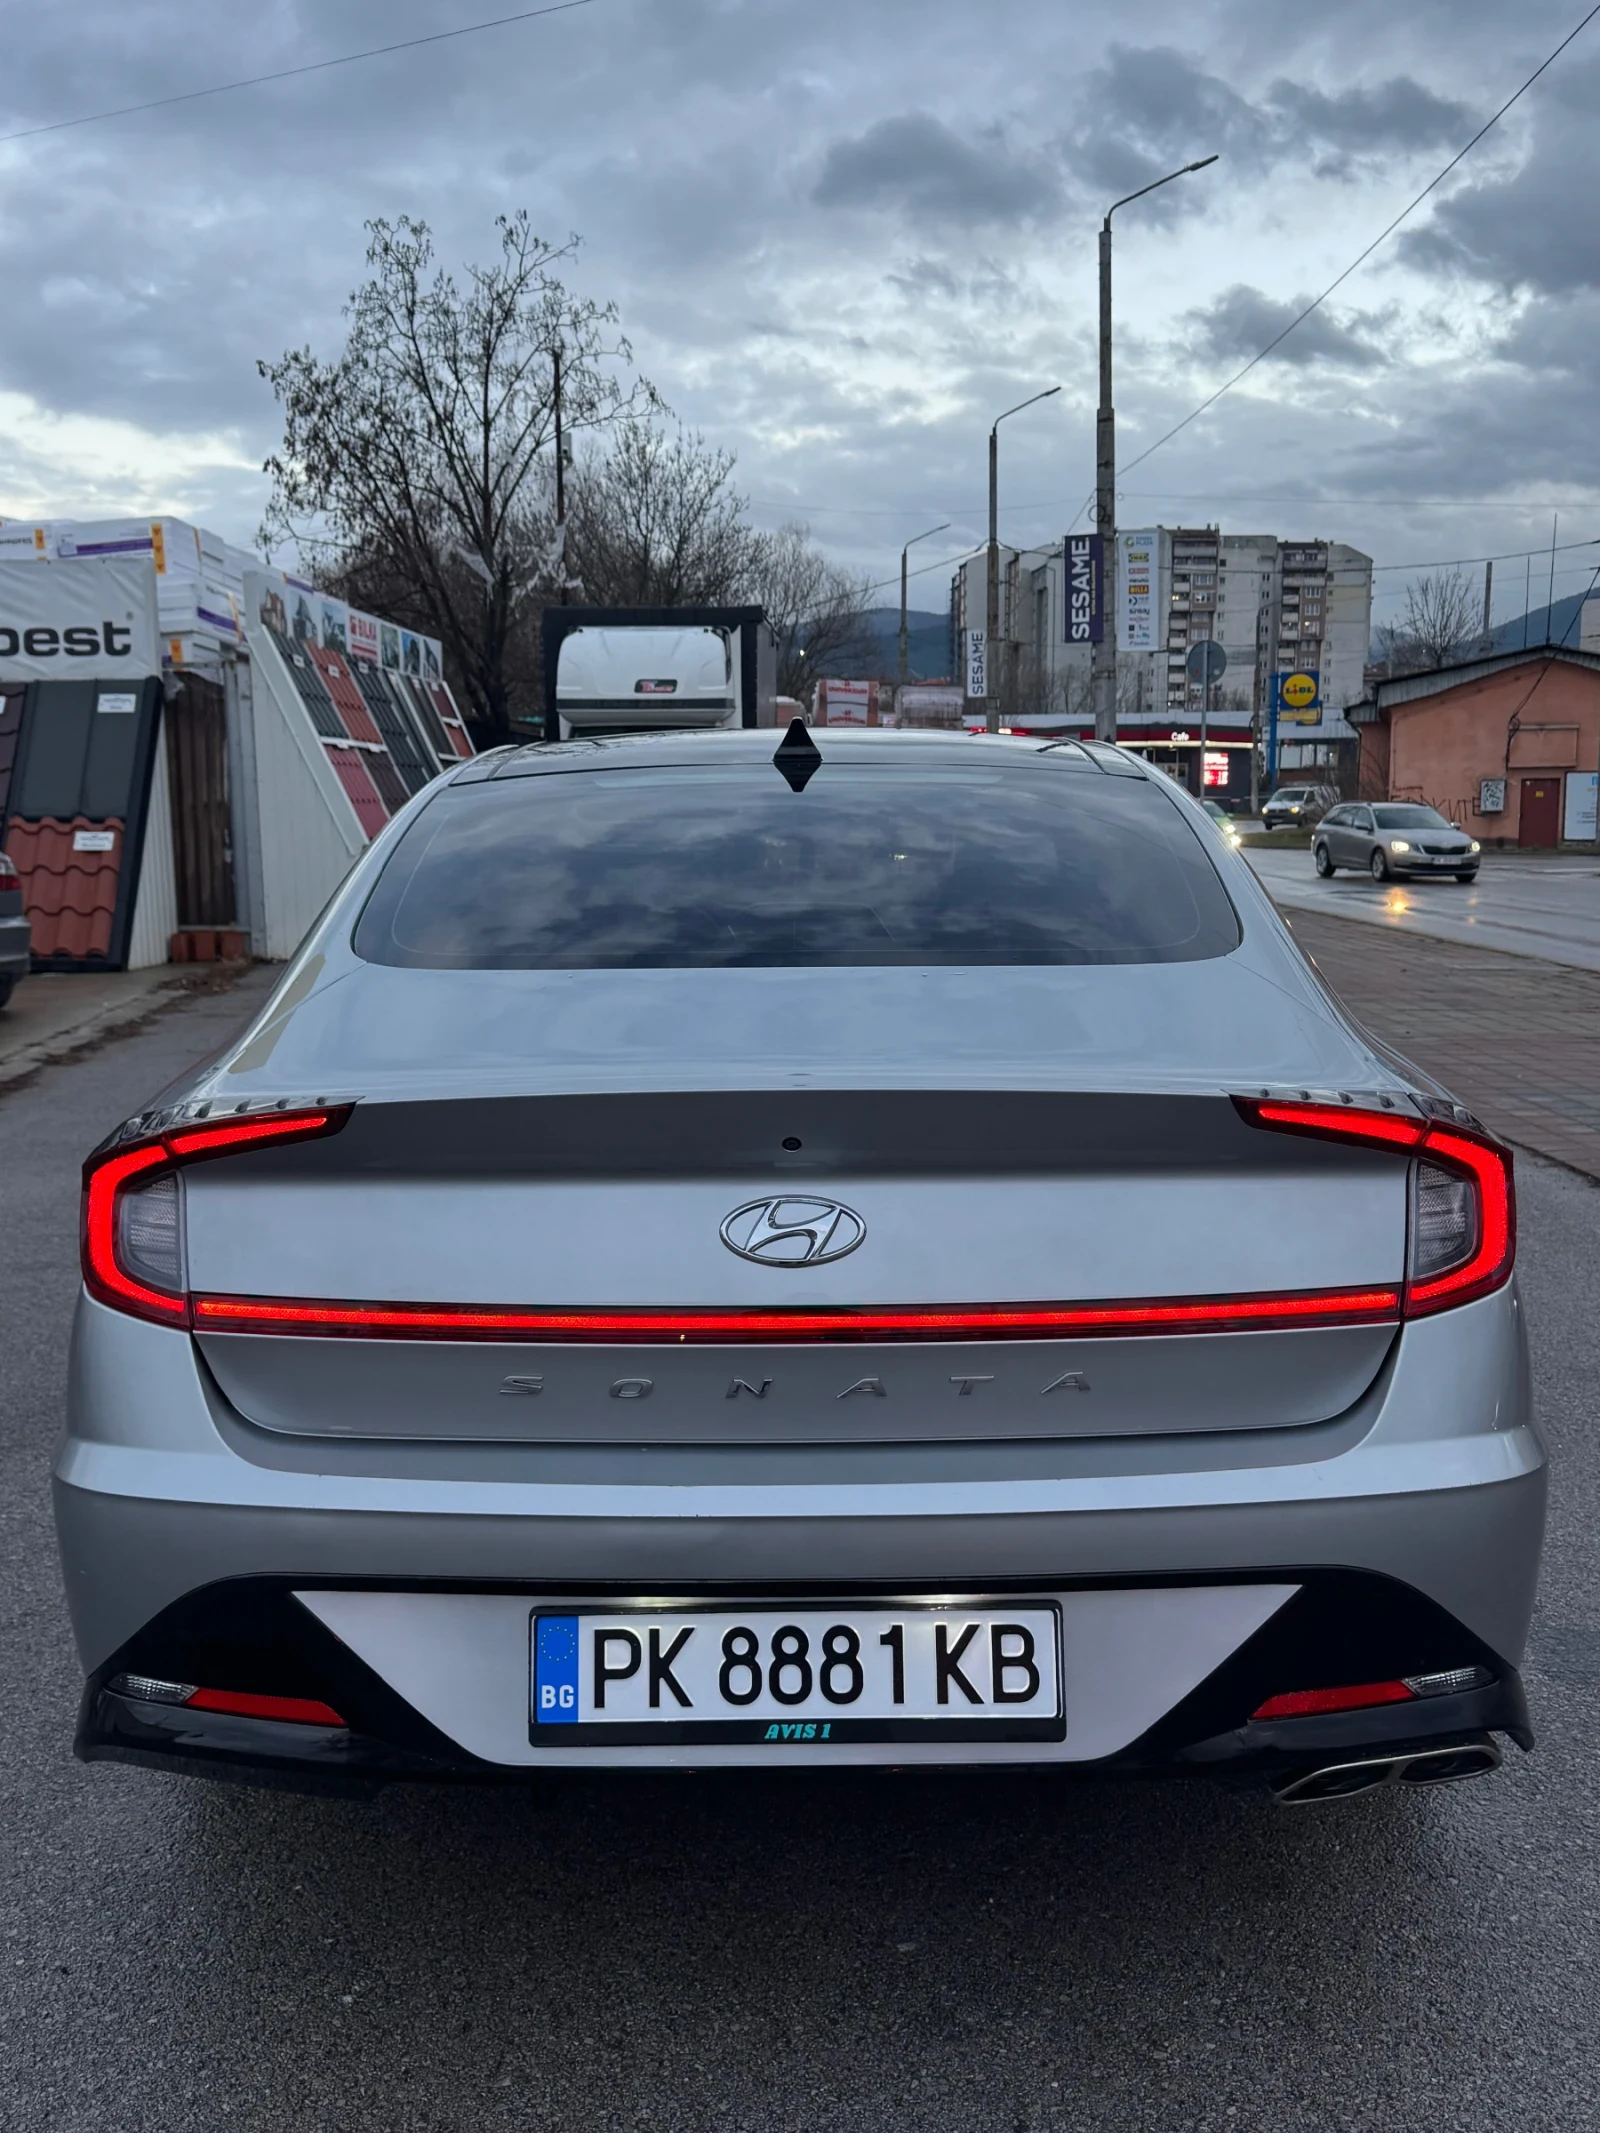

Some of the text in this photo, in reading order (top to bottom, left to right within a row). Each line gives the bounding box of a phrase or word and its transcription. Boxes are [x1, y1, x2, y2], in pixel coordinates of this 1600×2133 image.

[1072, 537, 1090, 640] SESAME
[972, 632, 984, 695] SESAME
[499, 1371, 1091, 1399] SONATA
[594, 1624, 1040, 1709] PK 8881 KB
[541, 1685, 574, 1708] BG
[764, 1723, 832, 1739] AVIS 1
